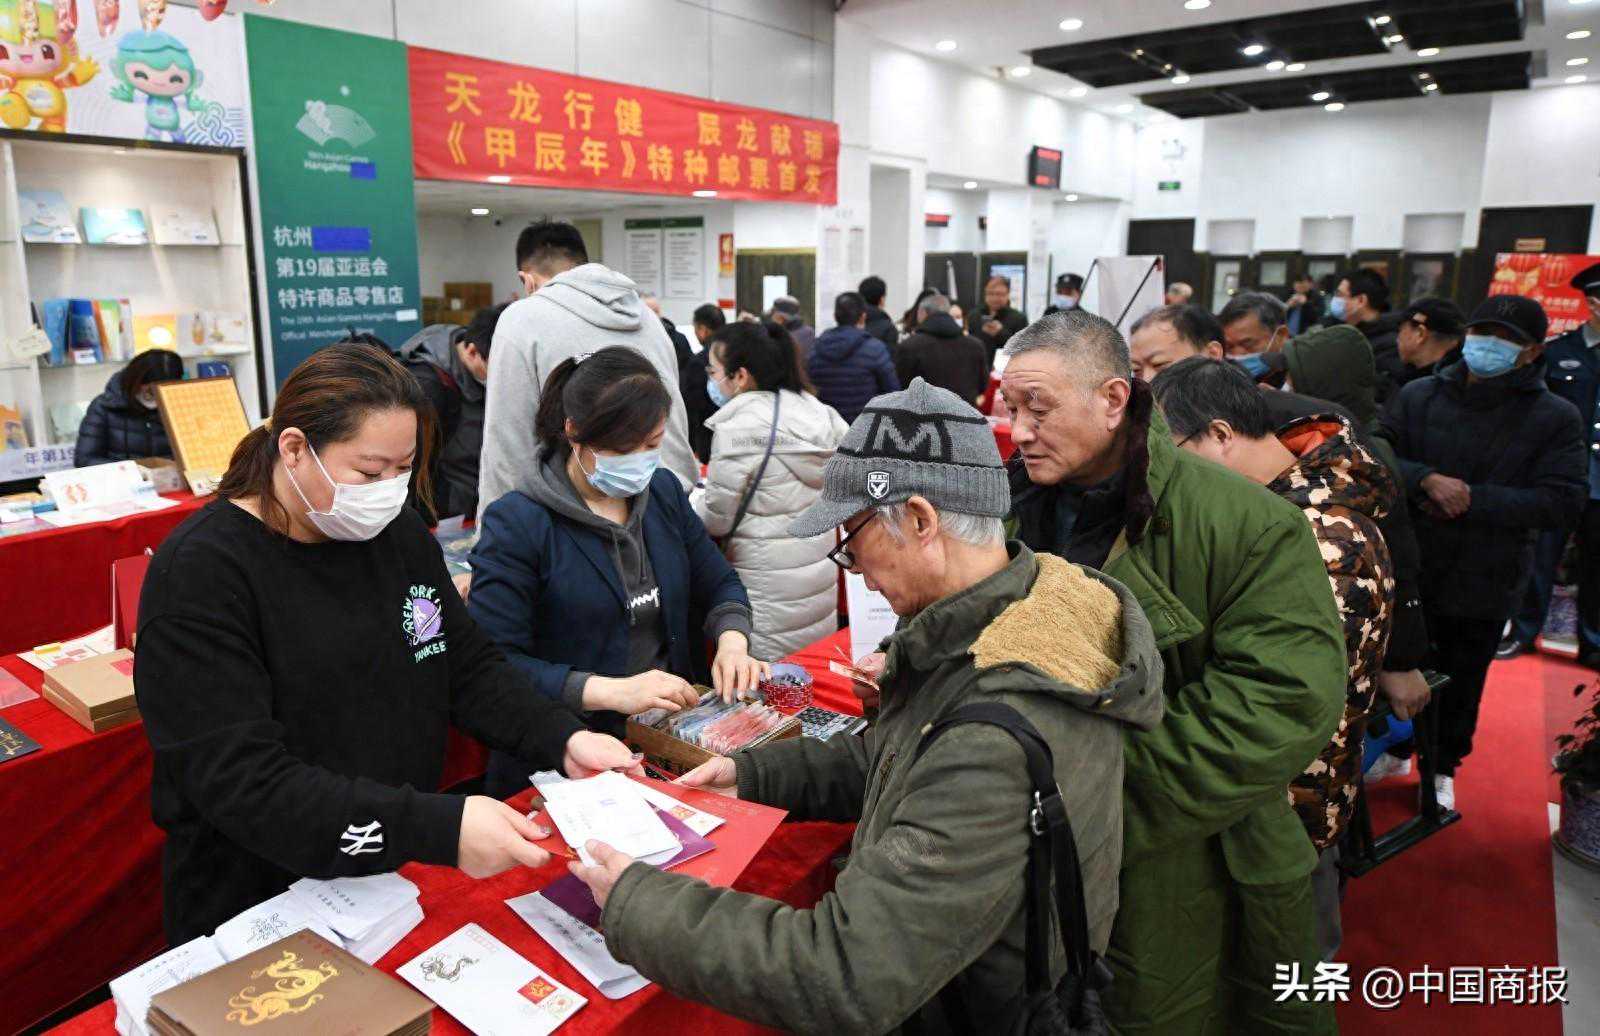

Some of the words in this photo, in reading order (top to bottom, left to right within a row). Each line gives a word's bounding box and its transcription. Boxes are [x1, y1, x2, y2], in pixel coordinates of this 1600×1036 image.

[444, 71, 645, 139] 天龙行健
[697, 110, 825, 161] 辰龙献瑞
[446, 121, 823, 194] 《甲辰年》特种邮票首发
[273, 225, 313, 247] 杭州
[275, 256, 388, 278] 第19届亚运会
[278, 285, 404, 309] 特许商品零售店
